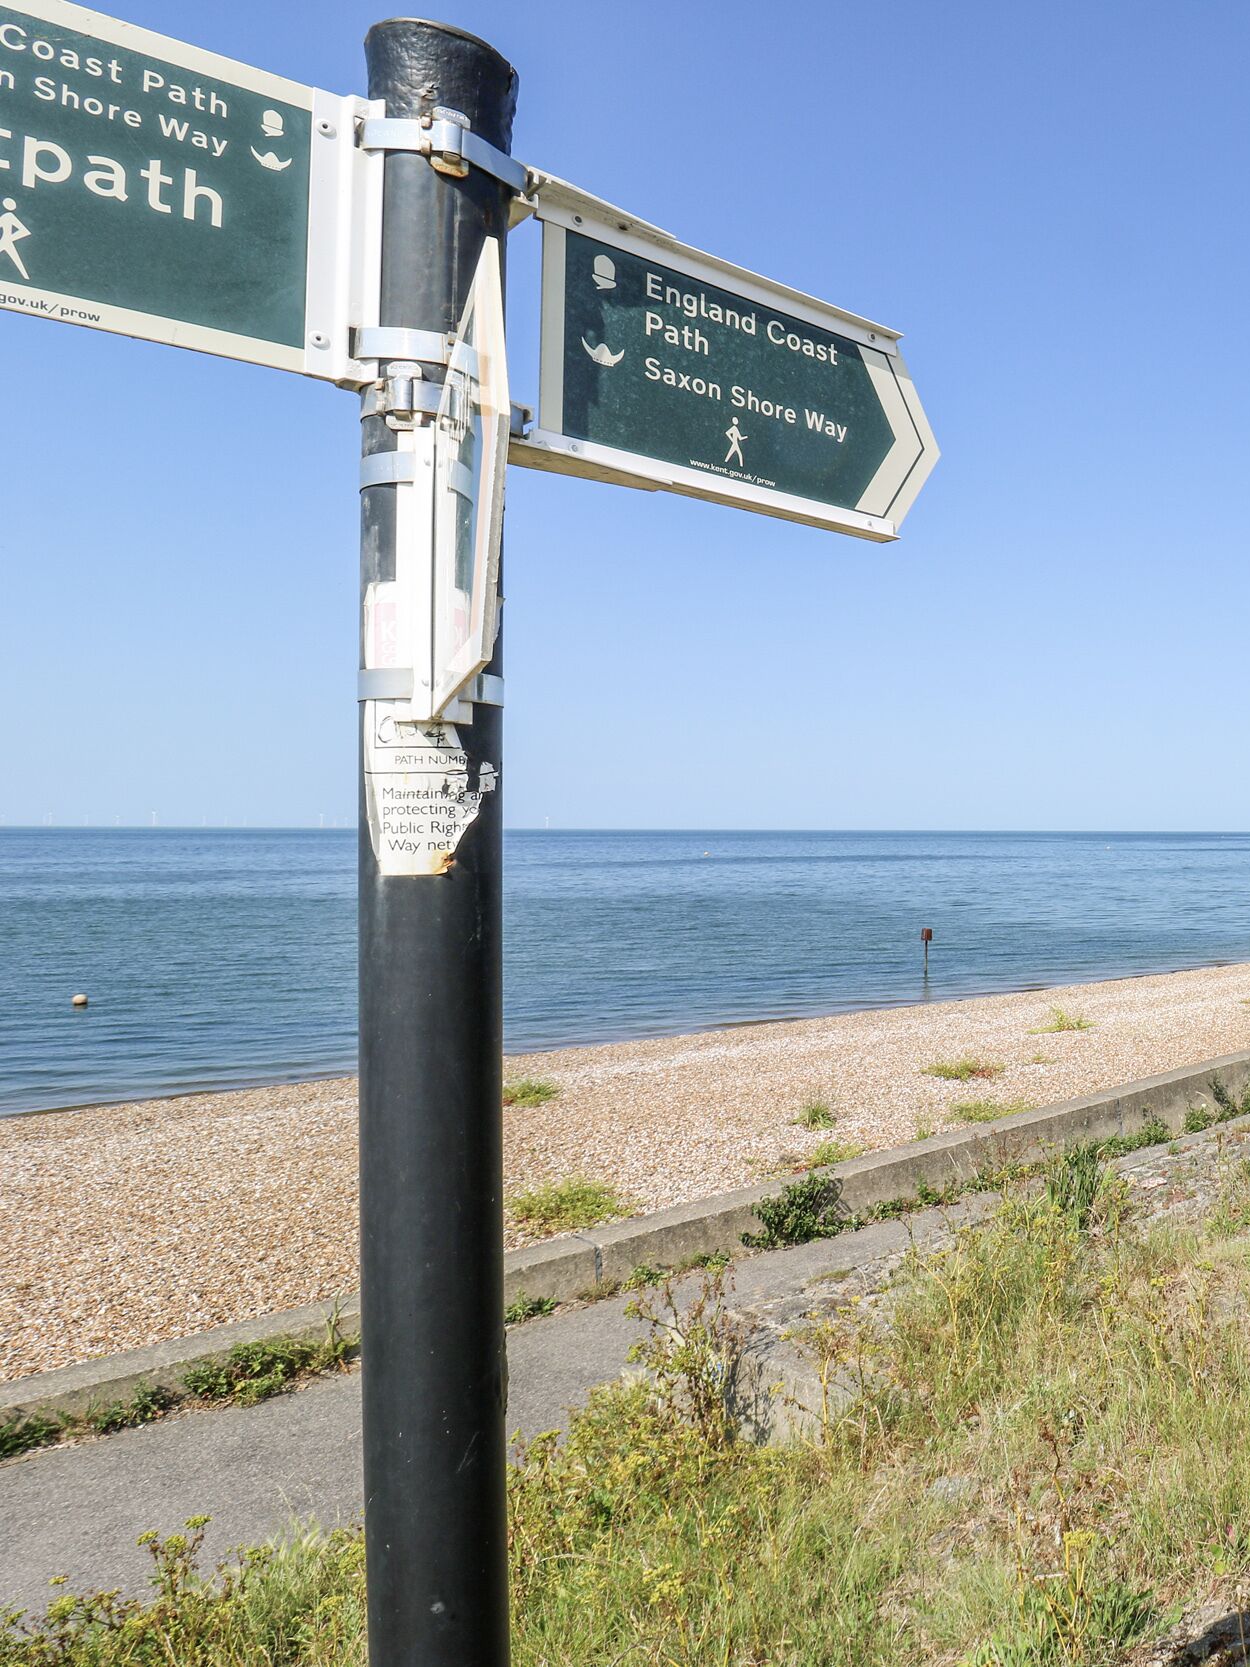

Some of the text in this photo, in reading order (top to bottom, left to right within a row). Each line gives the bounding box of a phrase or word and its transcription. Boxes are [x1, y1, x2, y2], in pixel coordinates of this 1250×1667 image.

[0, 23, 229, 118] Coast Path
[33, 76, 142, 128] Shore
[158, 114, 228, 157] Way
[645, 311, 709, 355] Path
[646, 272, 838, 365] England Coast
[644, 358, 847, 443] Saxon Shore Way
[689, 459, 776, 487] www.kent.gov.uk/prow
[394, 755, 424, 765] PATH
[383, 804, 456, 819] protecting
[383, 821, 424, 834] Public
[388, 839, 421, 854] Way
